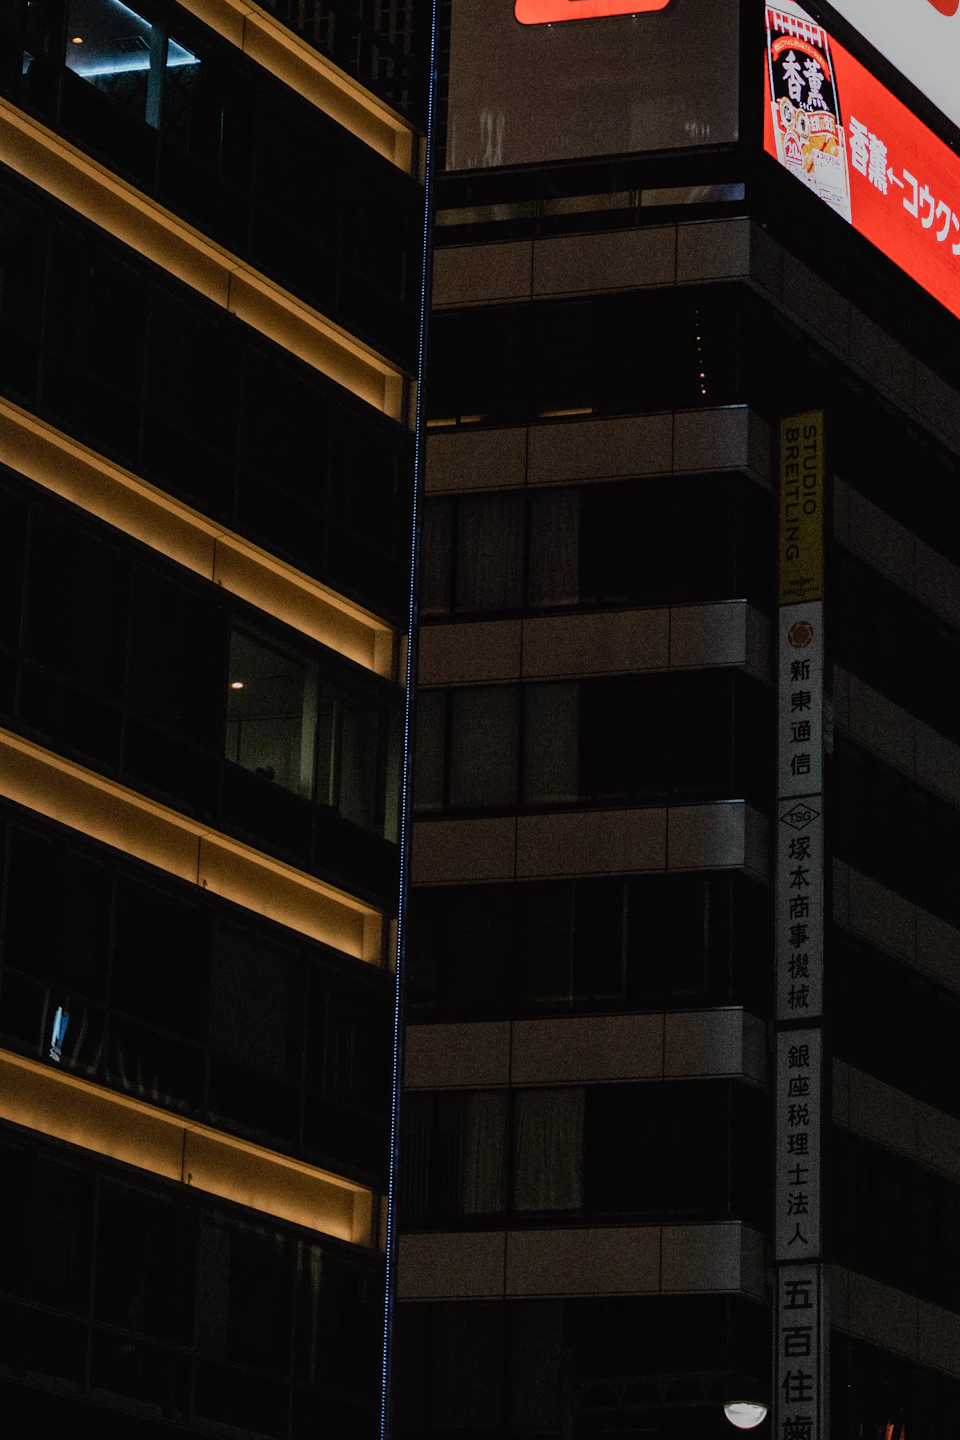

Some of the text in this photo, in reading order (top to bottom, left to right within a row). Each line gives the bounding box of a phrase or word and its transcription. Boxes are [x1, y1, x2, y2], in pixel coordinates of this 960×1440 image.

[781, 50, 829, 111] 香薫
[784, 427, 800, 562] BREITLING
[801, 424, 818, 516] STUDIO
[789, 657, 812, 777] 新東通信
[787, 835, 812, 1011] 塚本商事機械
[787, 1043, 811, 1247] 銀座税理士法人
